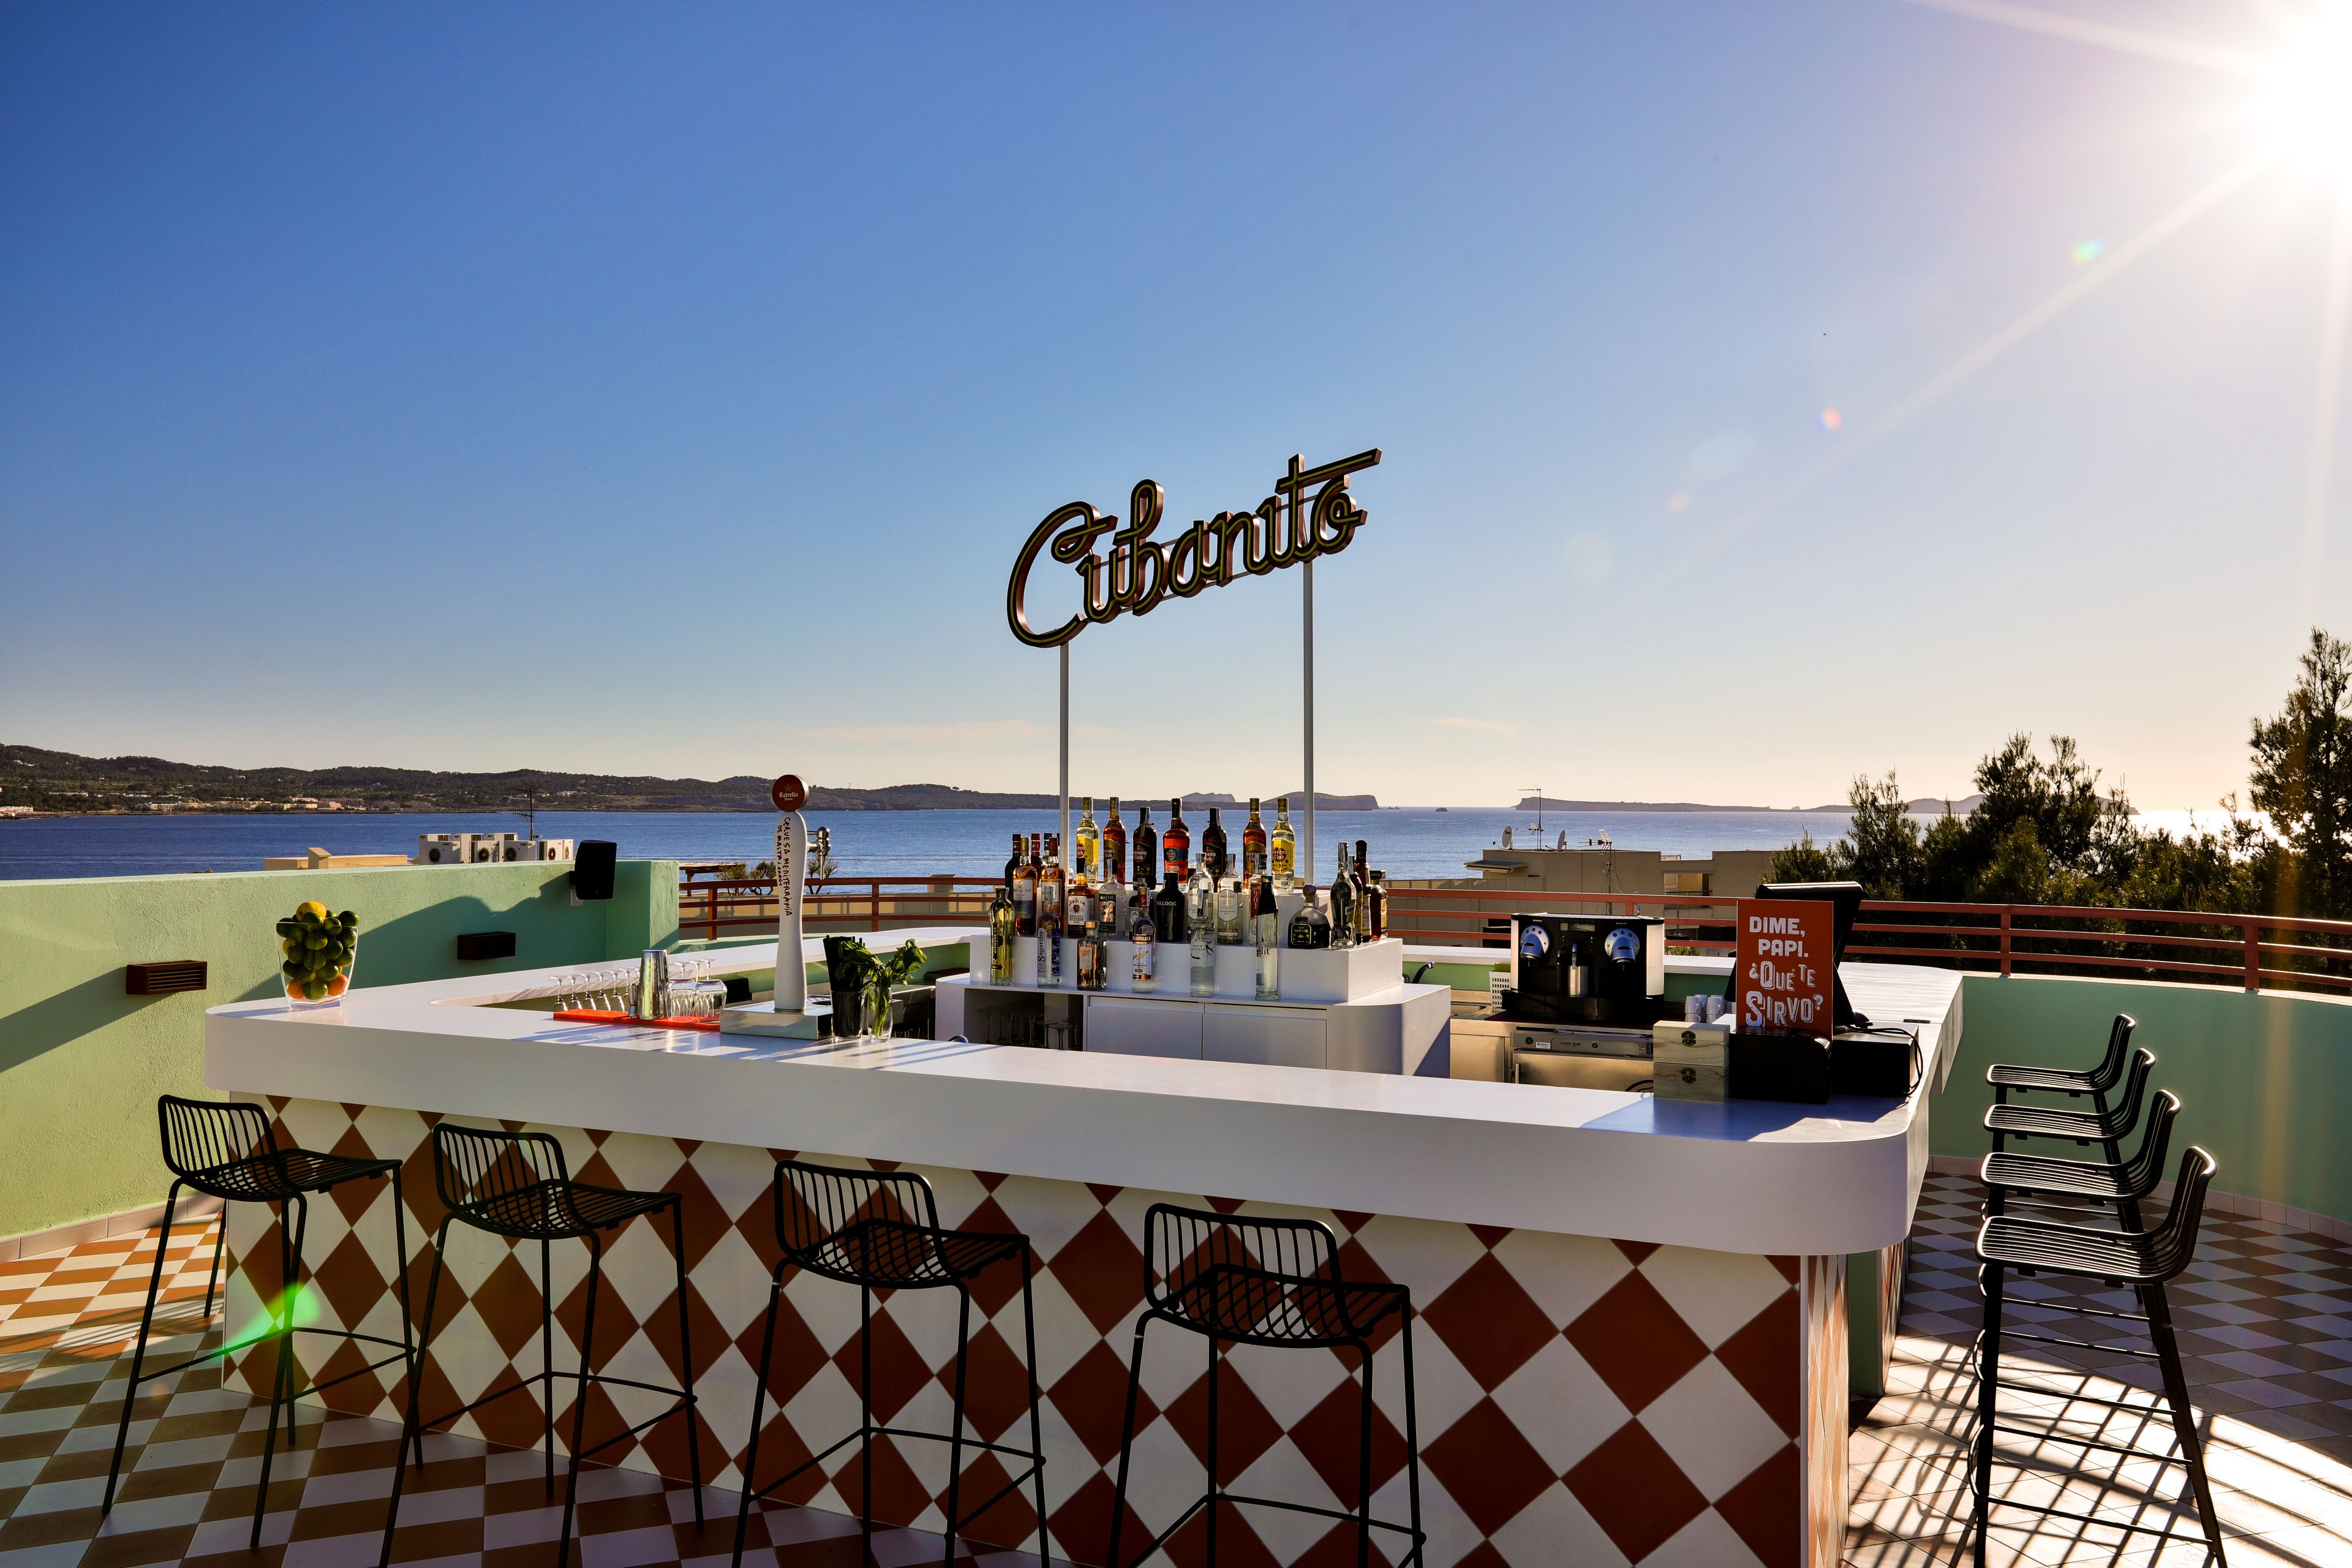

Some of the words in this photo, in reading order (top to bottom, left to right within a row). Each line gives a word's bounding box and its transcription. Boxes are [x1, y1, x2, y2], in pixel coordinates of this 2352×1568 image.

[1007, 448, 1382, 648] Cubanito
[1749, 916, 1806, 938] DIME,
[1256, 946, 1270, 955] elit
[1758, 938, 1809, 958] PAPI.
[1798, 963, 1816, 988] TE
[1746, 990, 1824, 1027] SIRVO?
